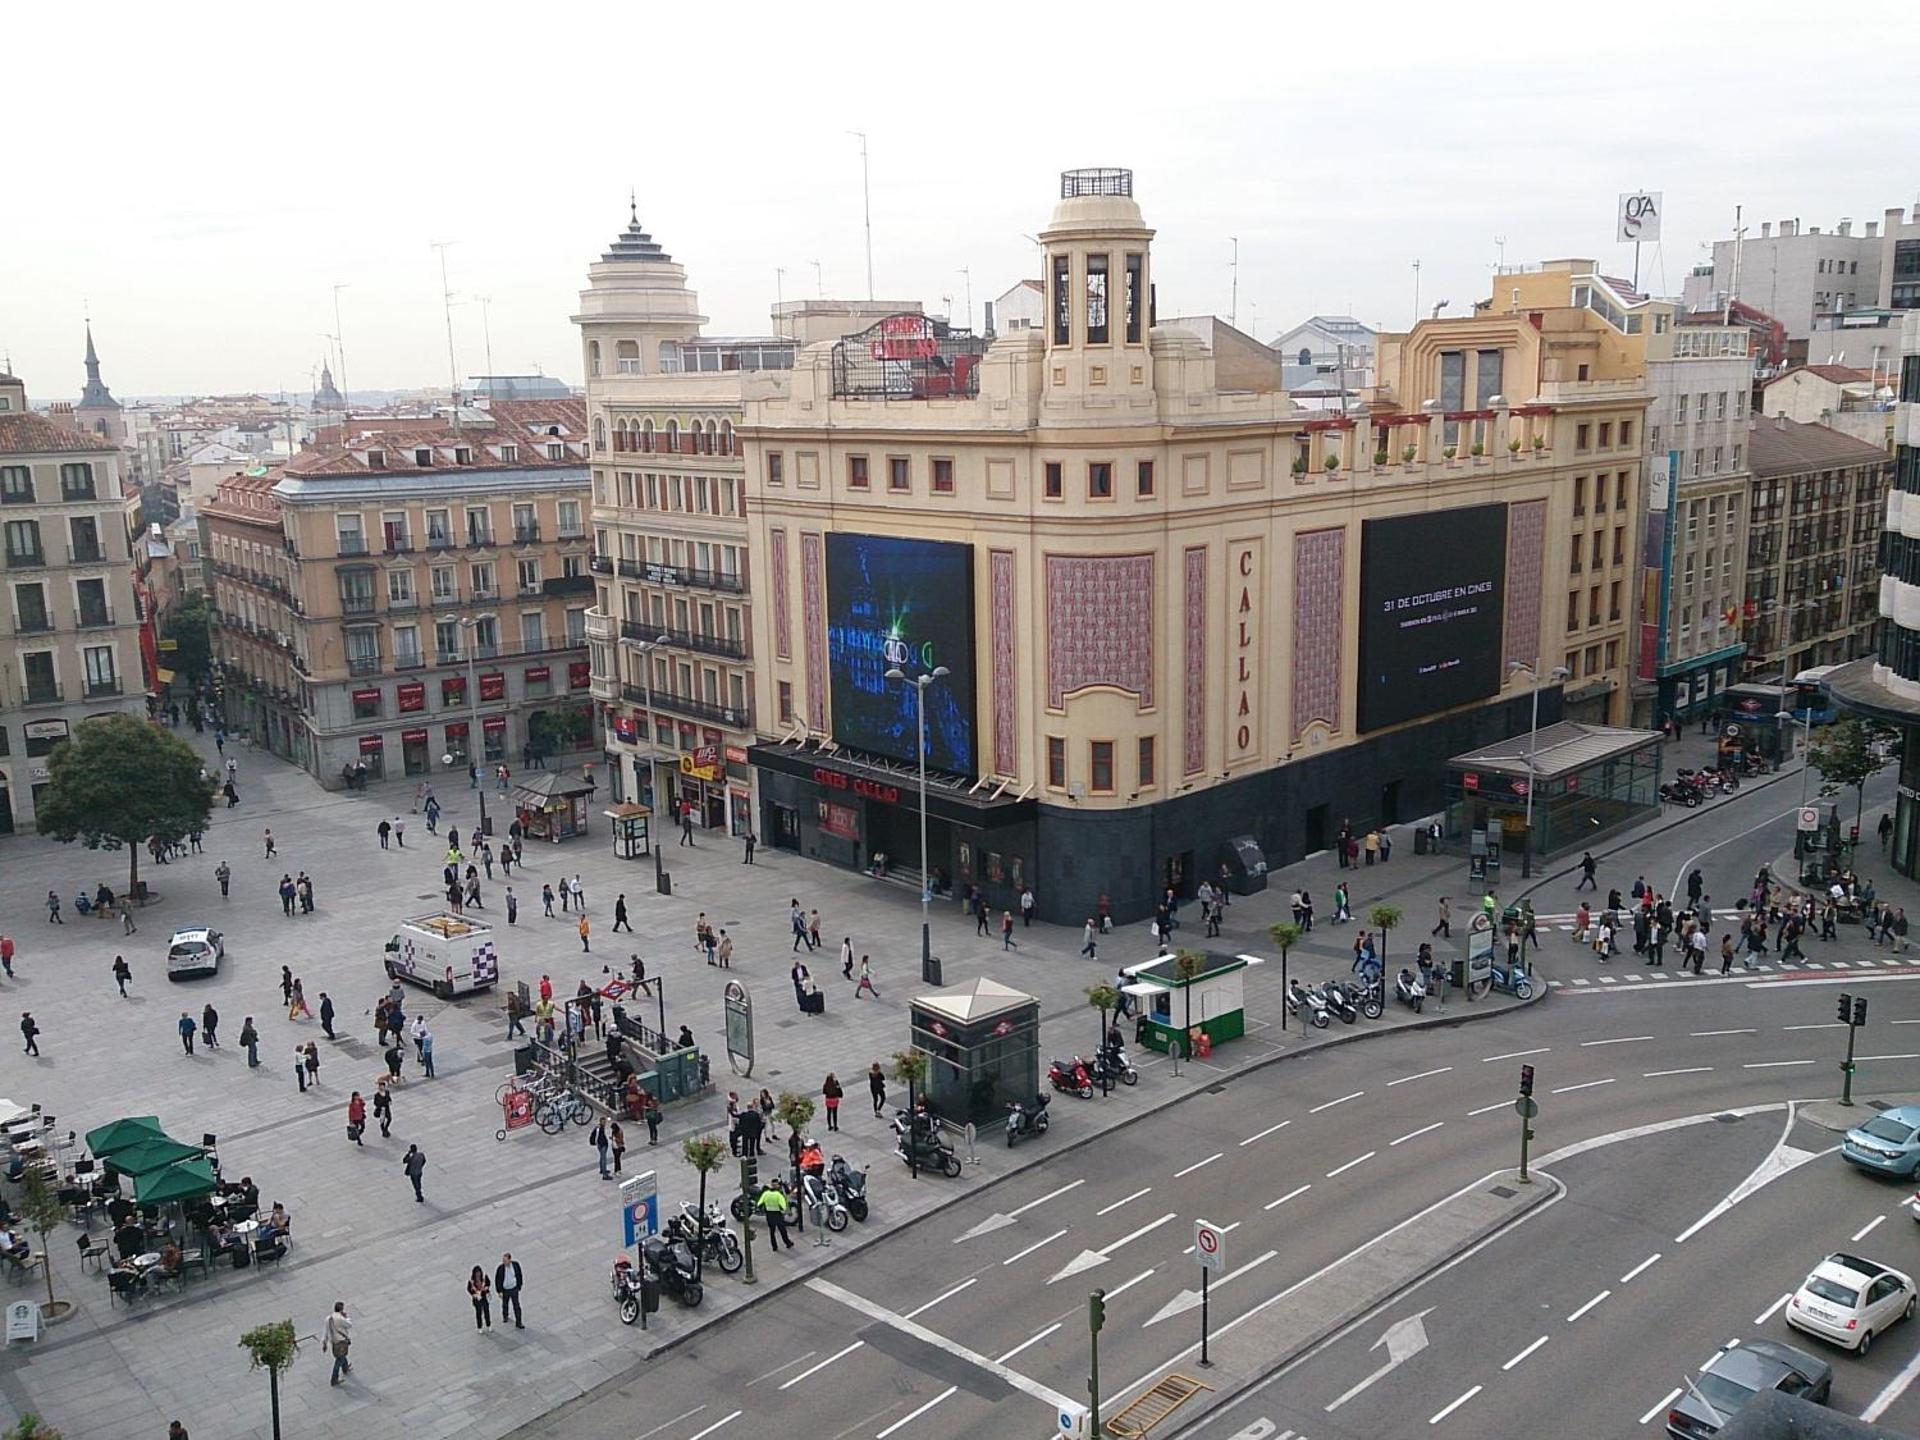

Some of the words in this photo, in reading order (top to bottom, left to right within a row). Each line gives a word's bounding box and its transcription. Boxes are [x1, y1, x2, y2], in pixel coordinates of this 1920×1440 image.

[1384, 600, 1395, 612] 31
[1398, 597, 1411, 609] DE
[1412, 589, 1453, 606] OCTUBRE
[1454, 586, 1467, 597] EN
[1467, 581, 1492, 594] CINES
[1237, 551, 1252, 750] CALLAO
[814, 769, 847, 789] CINES
